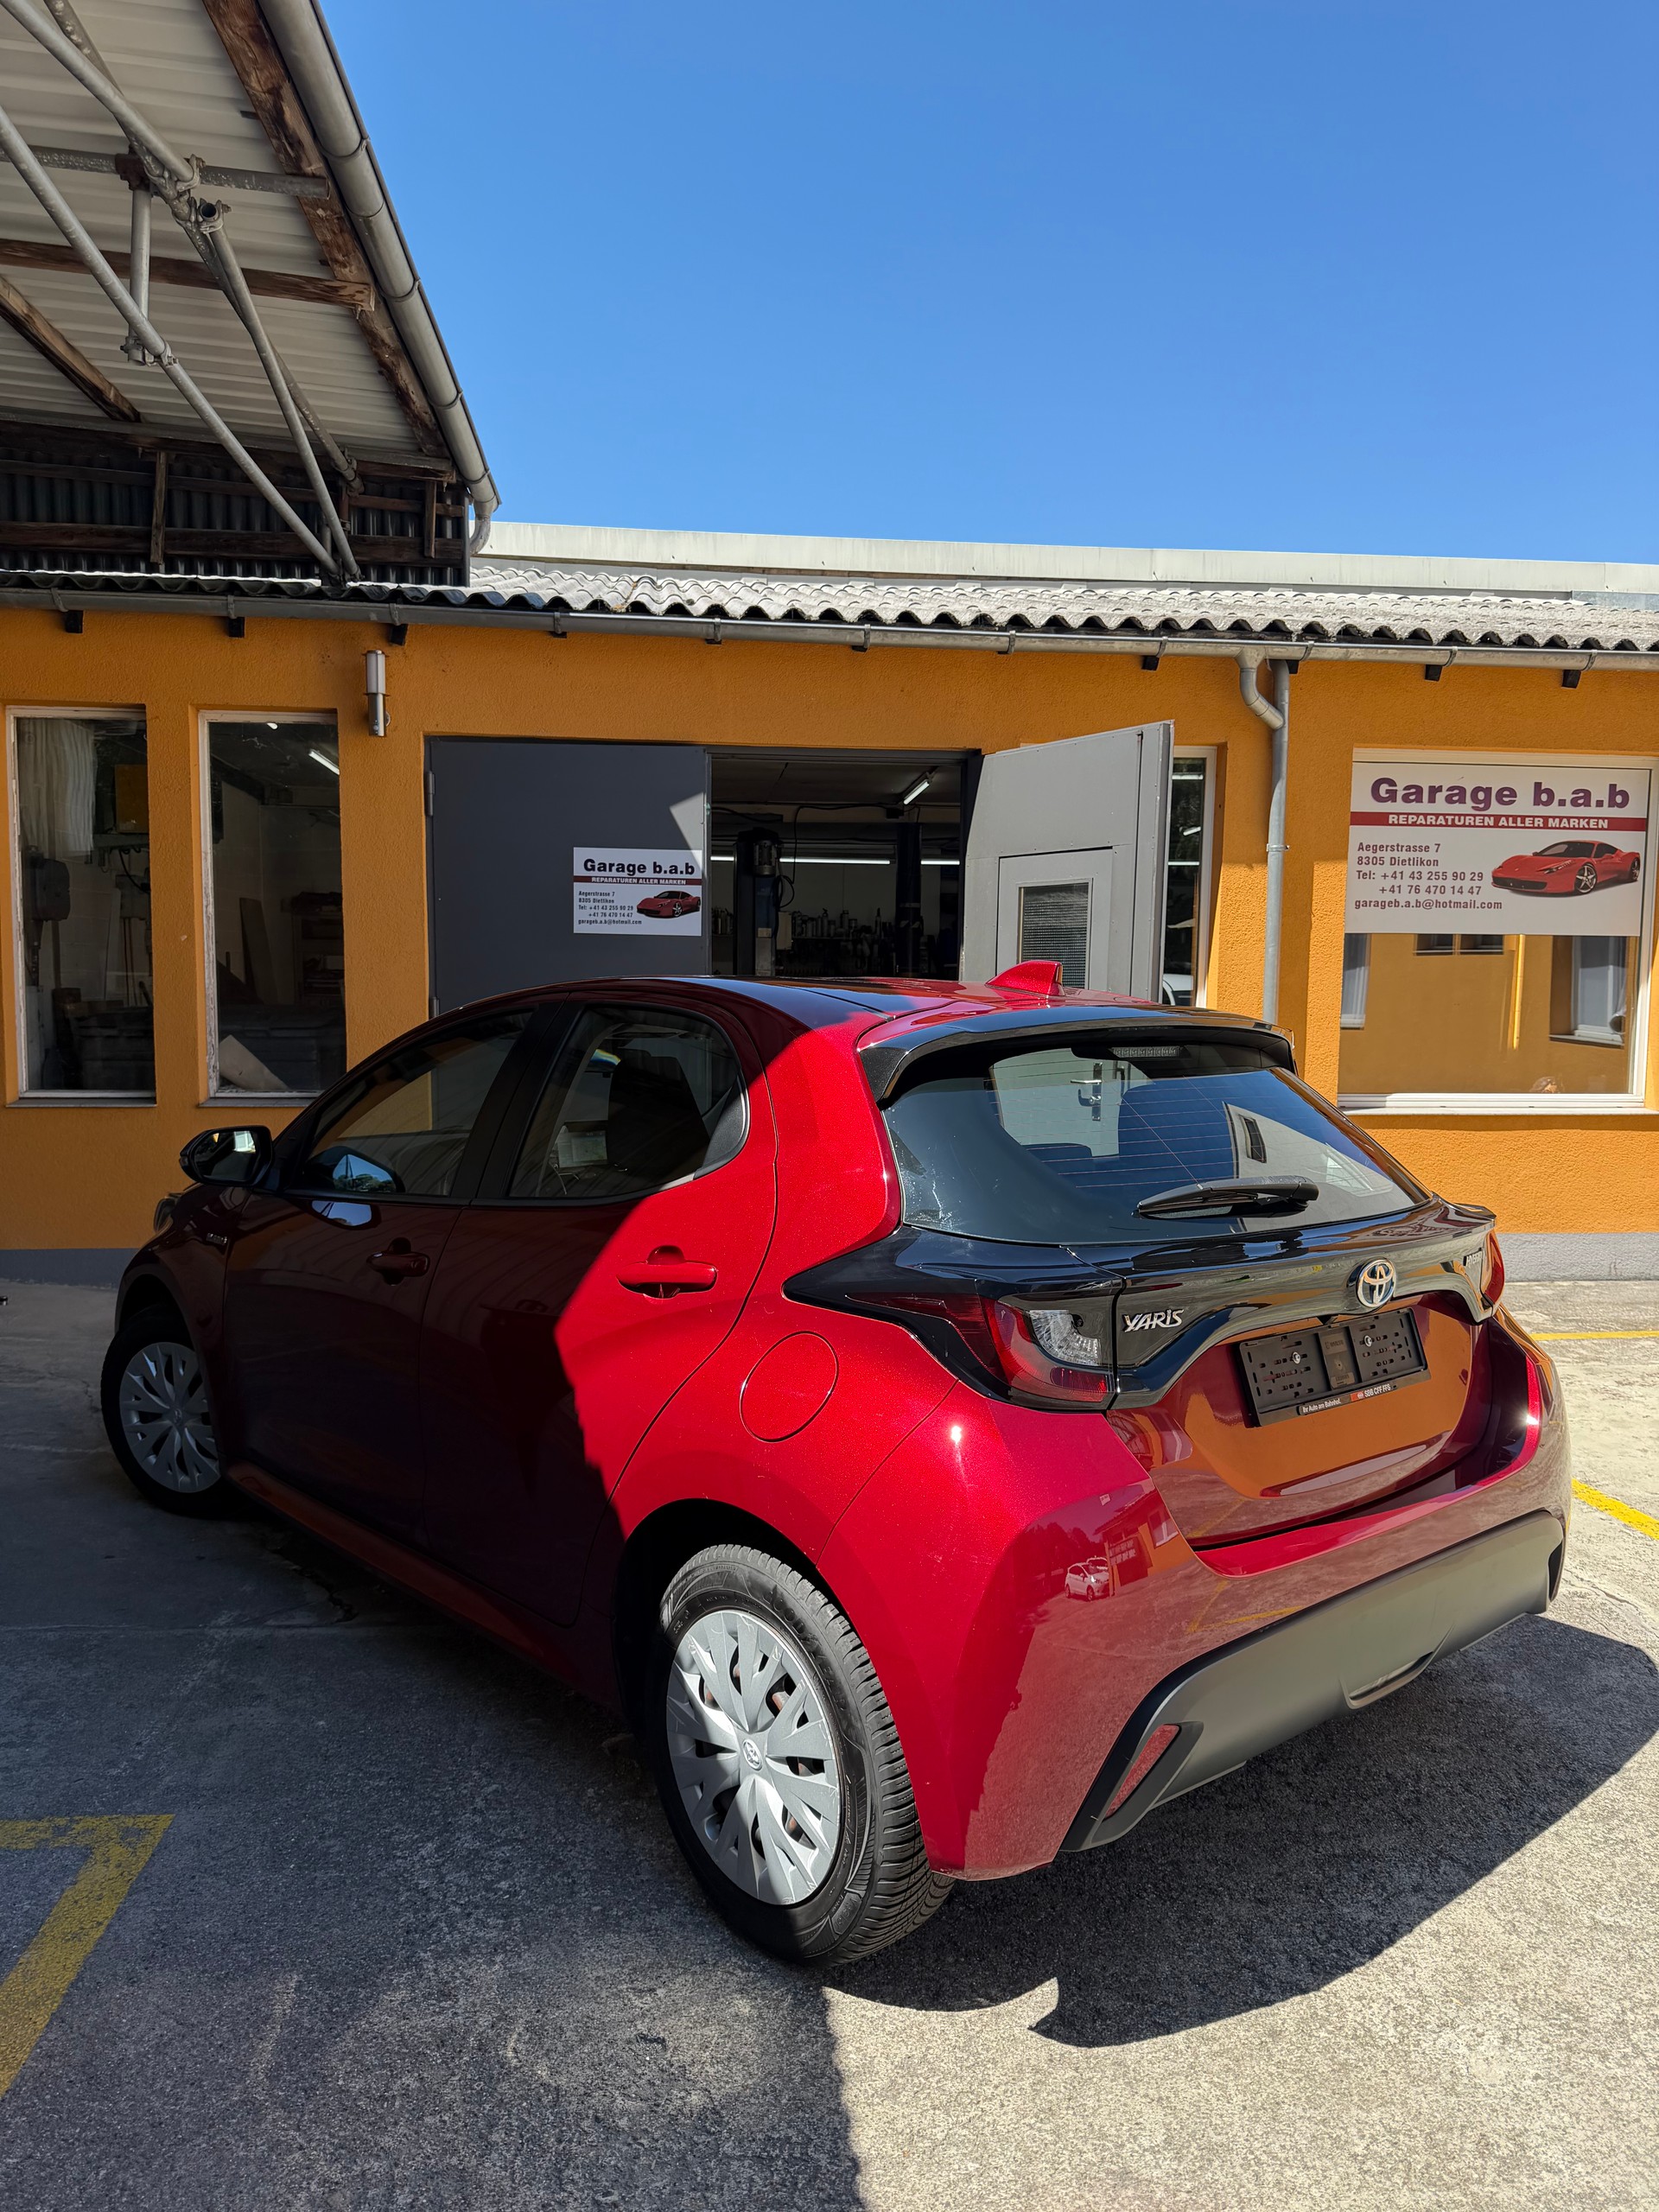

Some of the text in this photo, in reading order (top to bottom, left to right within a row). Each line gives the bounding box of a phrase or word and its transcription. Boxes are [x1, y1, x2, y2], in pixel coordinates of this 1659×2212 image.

[1370, 777, 1630, 811] Garage b.a.b
[1388, 814, 1609, 829] REPARATUREN ALLER MARKEN
[1357, 842, 1441, 854] Aegerstrasse 7
[583, 858, 695, 876] Garage b.a.b
[1357, 855, 1440, 867] 8305 Dietlikon
[1356, 869, 1484, 881] Tel: +41 43 255 90 29
[1379, 884, 1482, 895] +41 76 470 14 47
[1354, 899, 1503, 910] garageb.a.b@hotmail.com
[1123, 1309, 1185, 1332] YARIS
[1364, 1383, 1391, 1398] SBB CFF FFS
